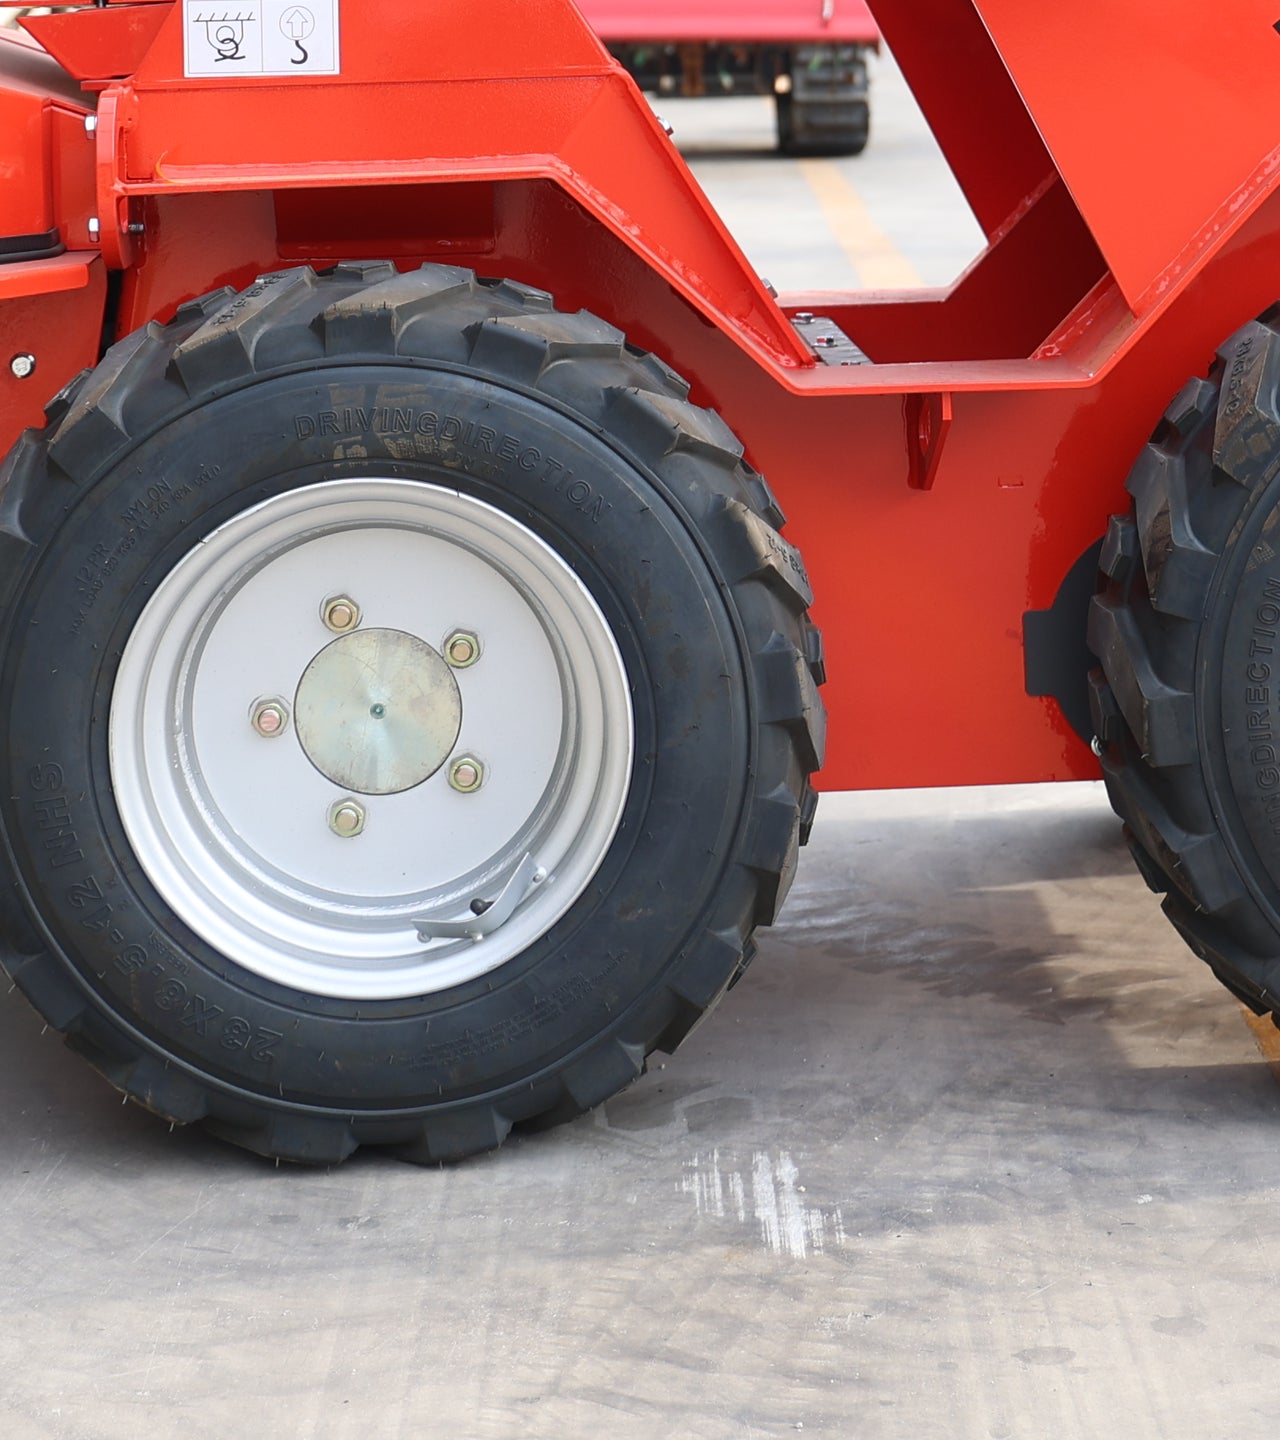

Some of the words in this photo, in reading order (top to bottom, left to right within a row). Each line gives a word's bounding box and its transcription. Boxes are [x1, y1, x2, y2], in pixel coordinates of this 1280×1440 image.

[117, 472, 174, 529] NYLON
[29, 762, 85, 871] NHS
[66, 874, 285, 1064] 23X8.5-12
